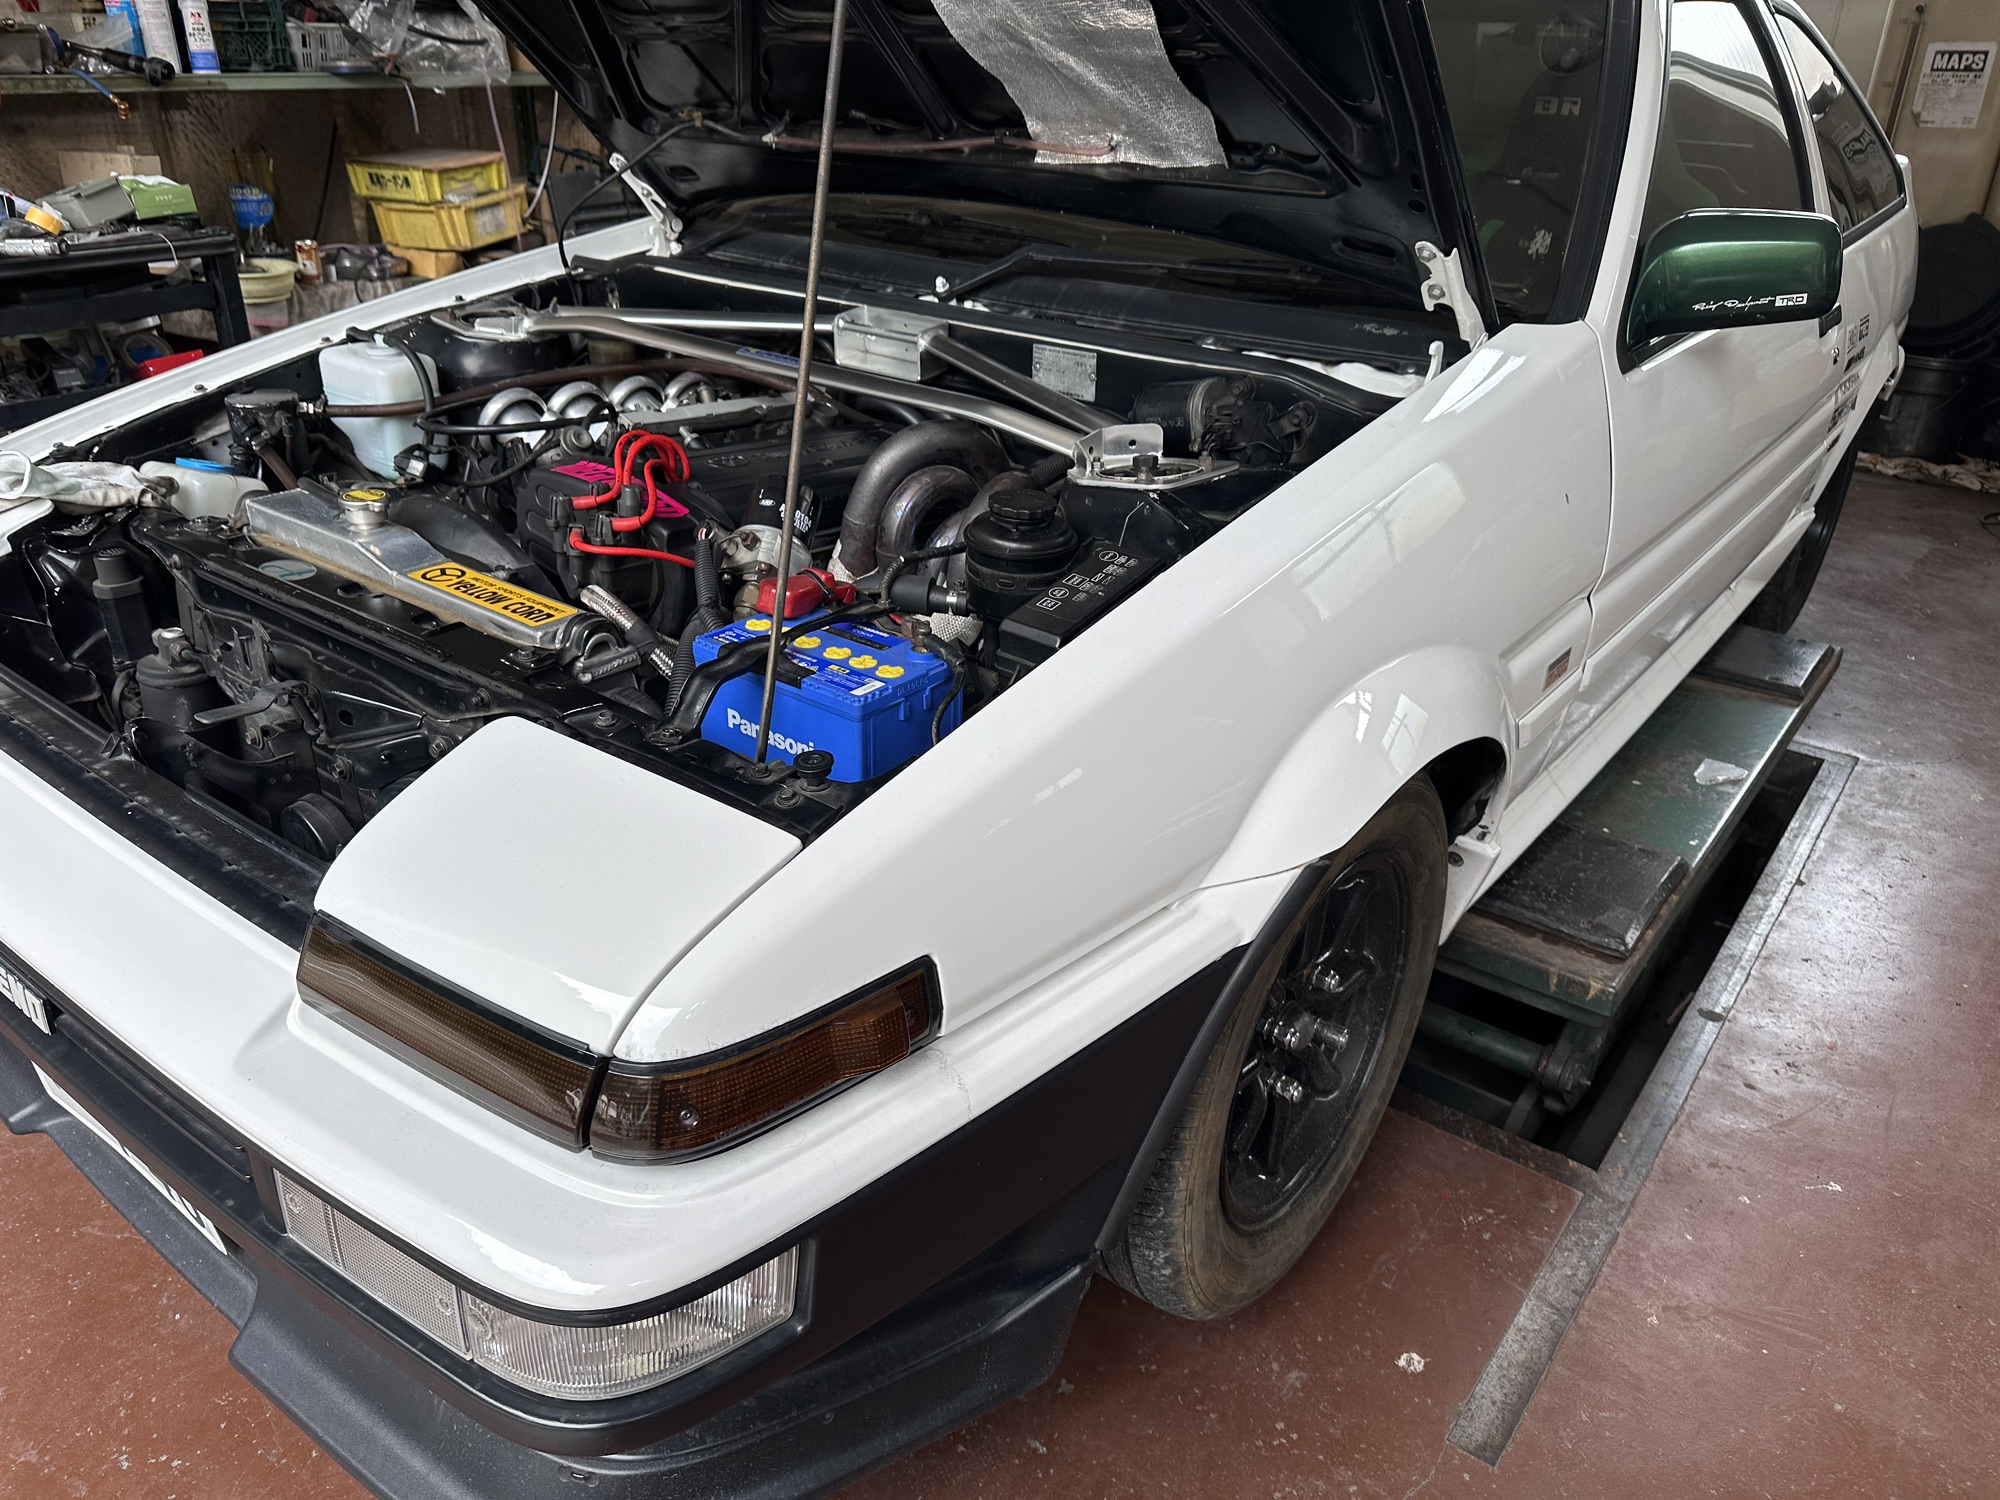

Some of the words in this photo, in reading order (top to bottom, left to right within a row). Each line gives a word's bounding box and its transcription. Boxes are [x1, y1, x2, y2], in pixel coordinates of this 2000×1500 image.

[1933, 53, 1985, 69] MAPS
[1776, 293, 1808, 306] TRD
[523, 596, 567, 614] EQUIPMENT
[727, 708, 815, 755] Panasoni
